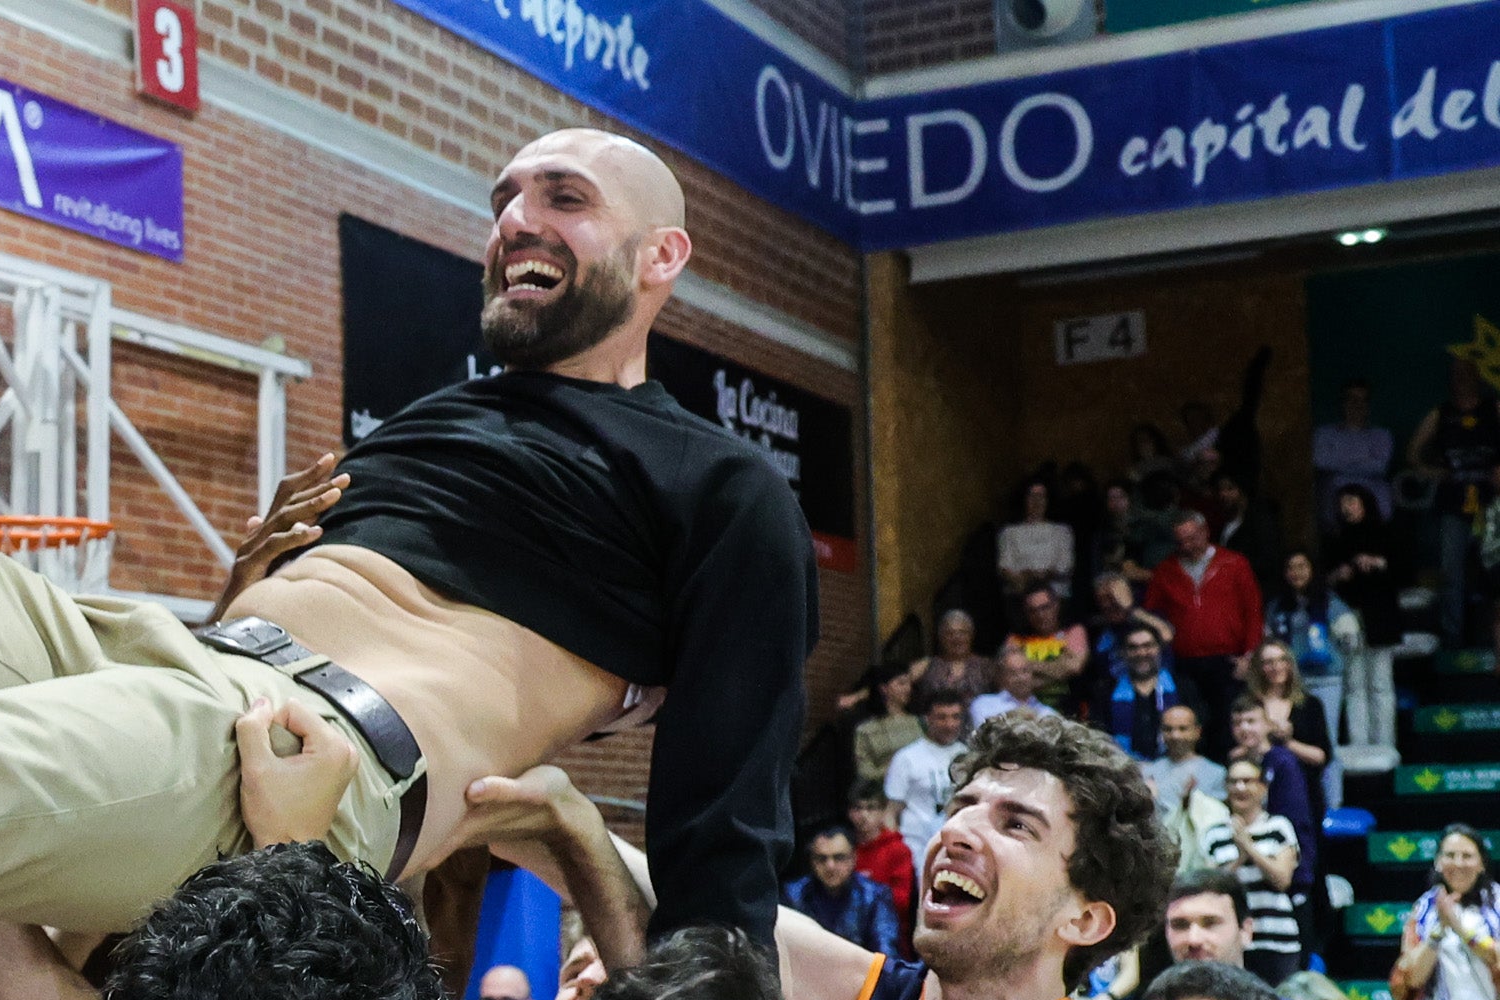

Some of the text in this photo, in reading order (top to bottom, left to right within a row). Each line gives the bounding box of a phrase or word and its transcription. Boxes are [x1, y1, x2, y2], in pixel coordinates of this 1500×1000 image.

[157, 5, 186, 93] 3
[756, 66, 1094, 214] OVIEDO
[1063, 316, 1137, 359] F 4
